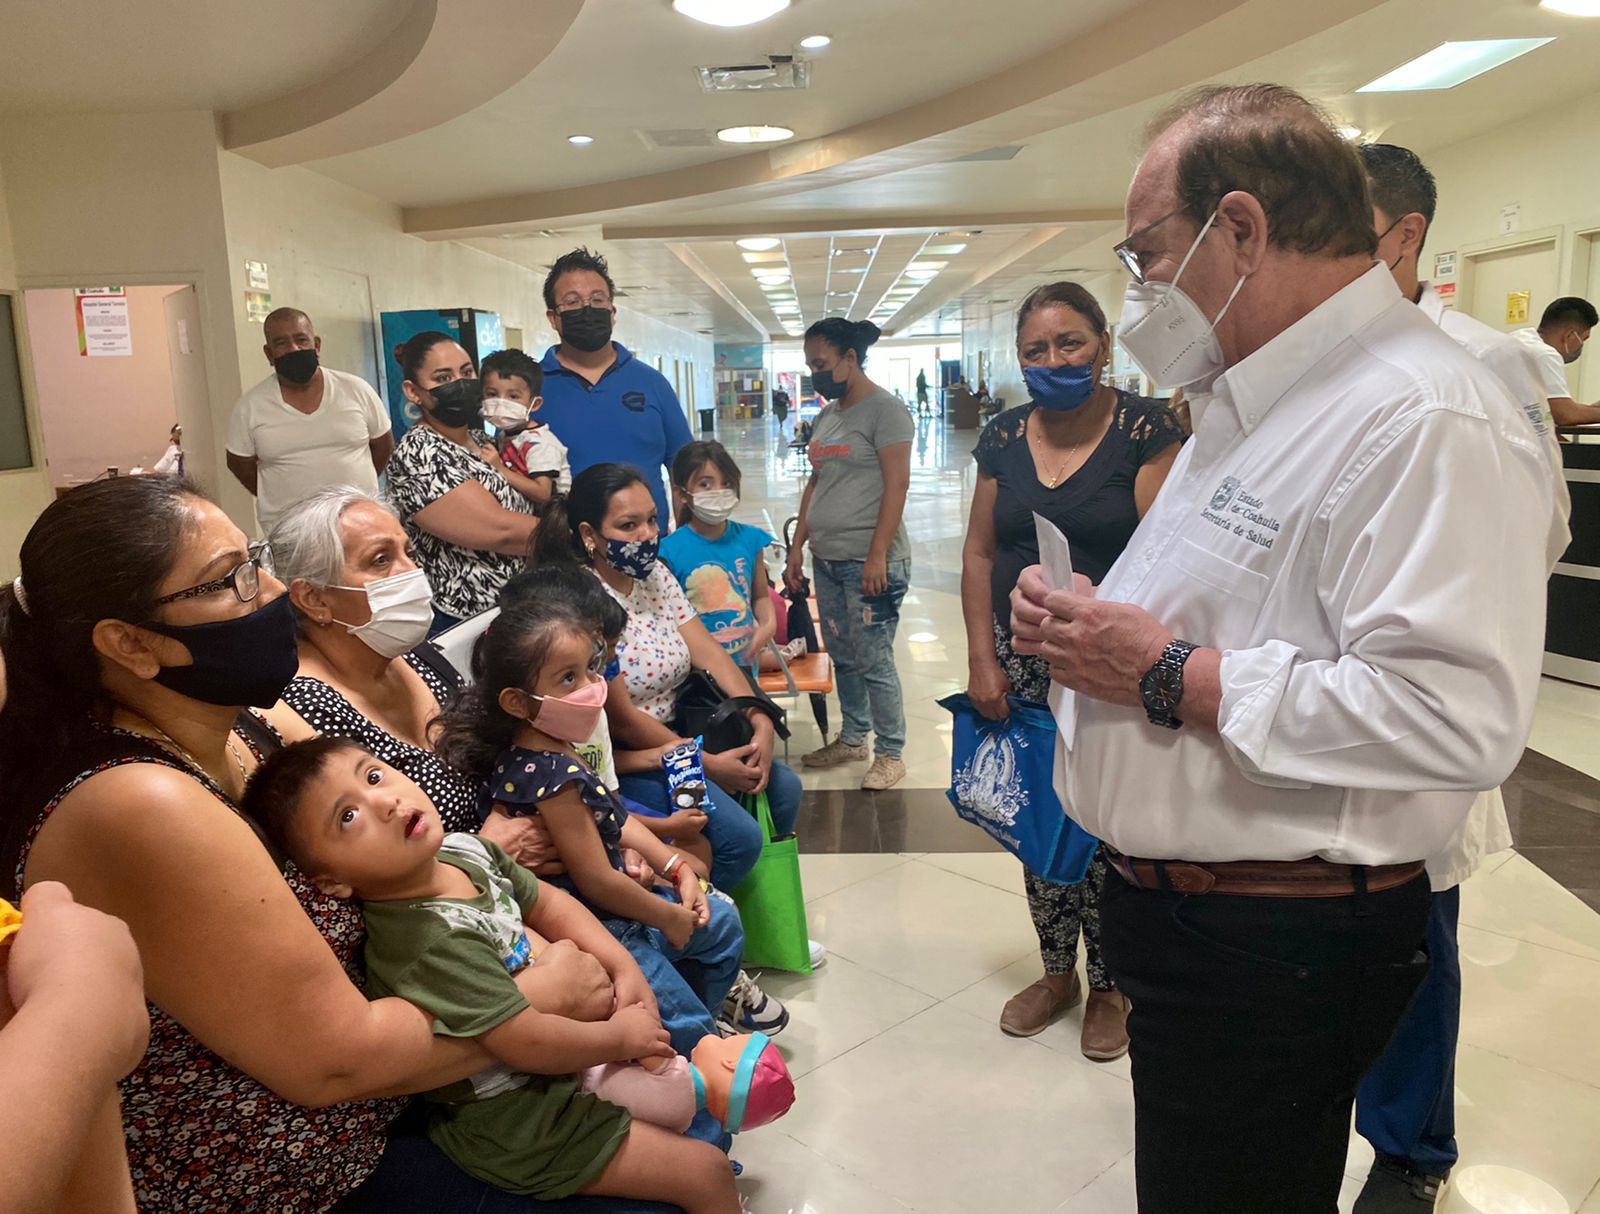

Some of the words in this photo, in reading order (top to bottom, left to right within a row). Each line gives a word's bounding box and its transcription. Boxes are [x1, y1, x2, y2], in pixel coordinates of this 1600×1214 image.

[1237, 491, 1263, 509] Estado
[1242, 509, 1280, 532] Coahuila
[1233, 525, 1244, 536] de
[1246, 530, 1273, 549] Salud
